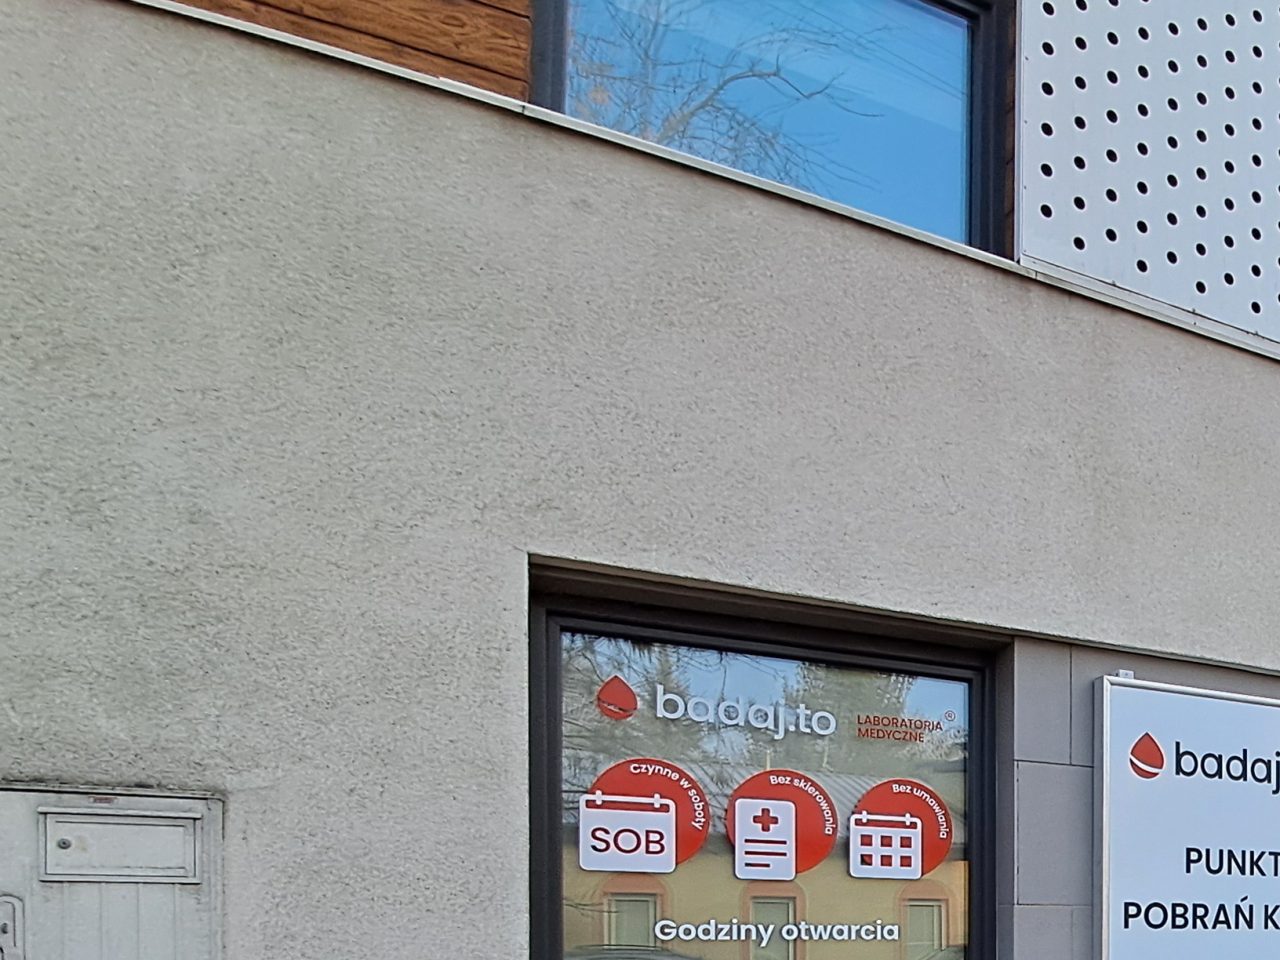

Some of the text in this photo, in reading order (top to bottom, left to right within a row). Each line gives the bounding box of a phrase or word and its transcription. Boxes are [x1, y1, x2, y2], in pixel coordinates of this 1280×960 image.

[655, 685, 837, 740] badaj.to
[857, 728, 925, 743] MEDYCZNE
[630, 763, 706, 830] Czynne w soboty
[769, 775, 834, 836] Bez skierowania
[892, 783, 950, 839] Bez umawiania
[590, 827, 666, 855] SOB
[653, 918, 900, 948] Godziny otwarcia
[1123, 895, 1254, 930] POBRAŃ
